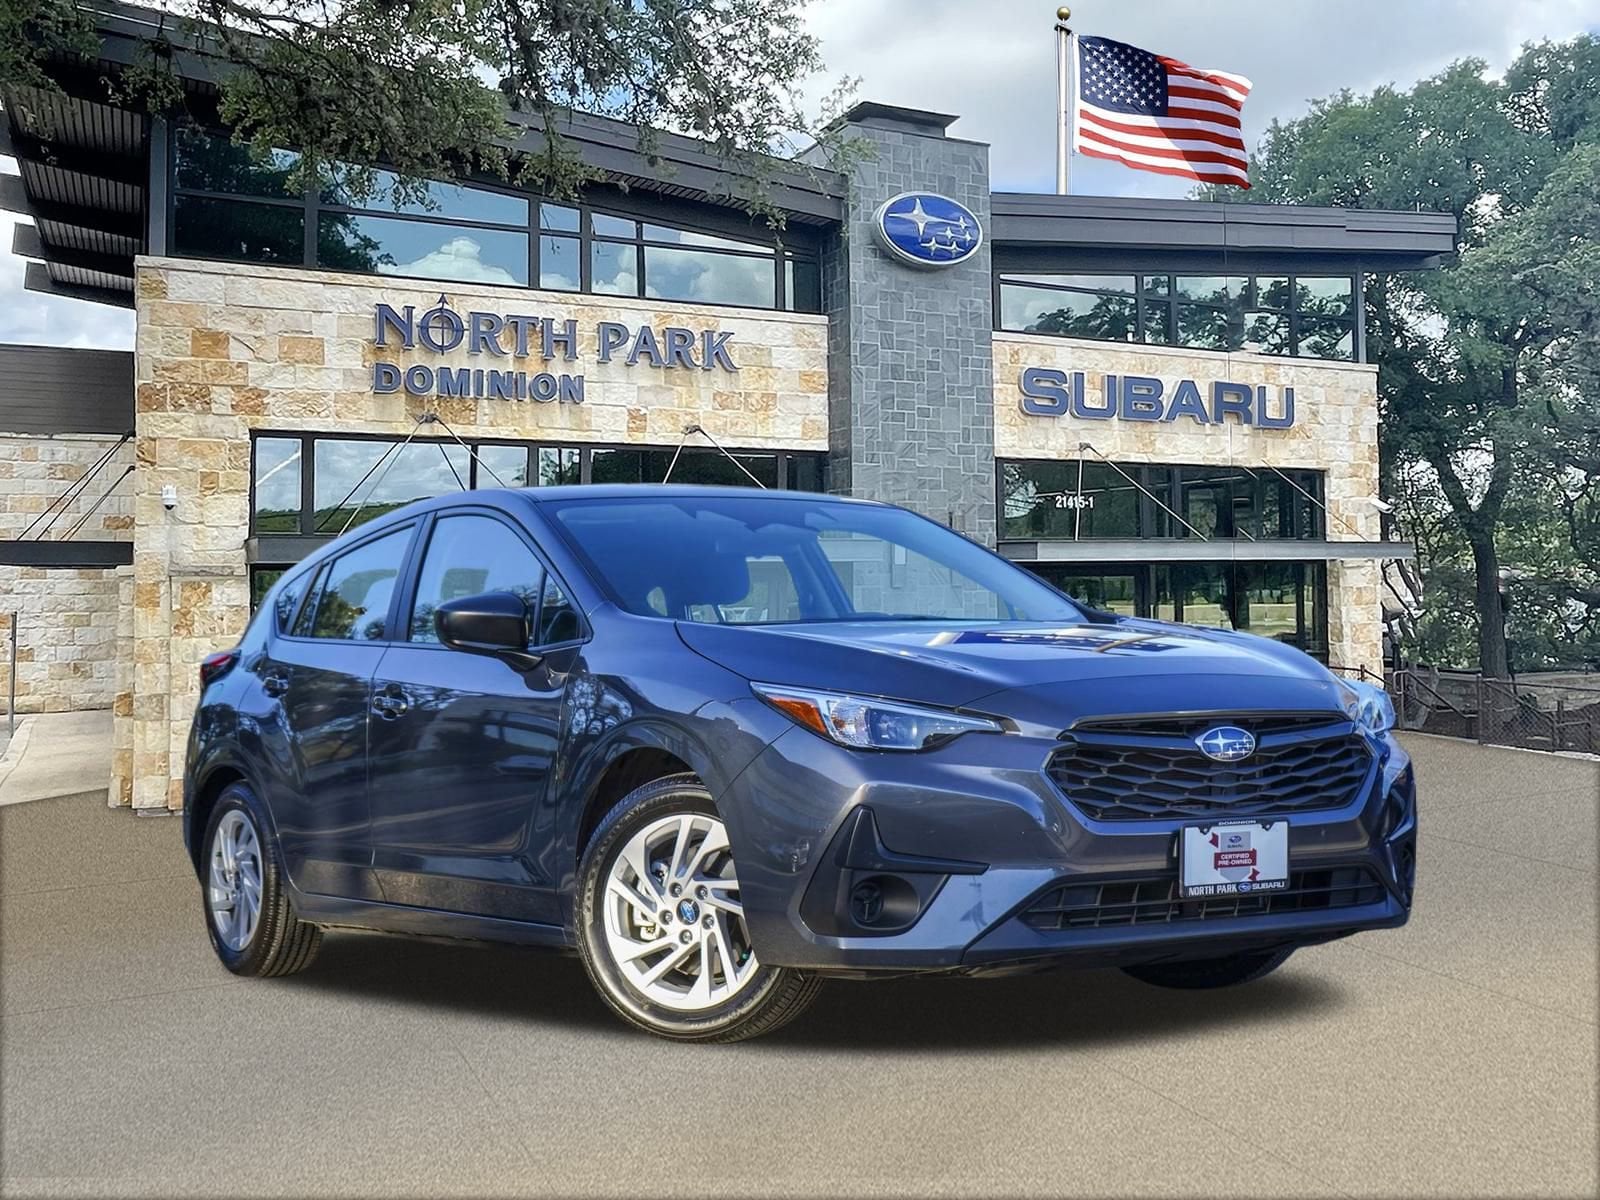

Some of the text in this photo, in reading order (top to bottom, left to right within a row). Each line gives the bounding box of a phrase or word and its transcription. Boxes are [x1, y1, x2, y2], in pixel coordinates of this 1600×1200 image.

[375, 296, 742, 372] NORTH PARK
[373, 362, 585, 404] DOMINION
[1019, 367, 1294, 430] SUBARU
[1055, 495, 1094, 509] 21415-1
[1188, 881, 1285, 896] NORTH PARK SUBARU
